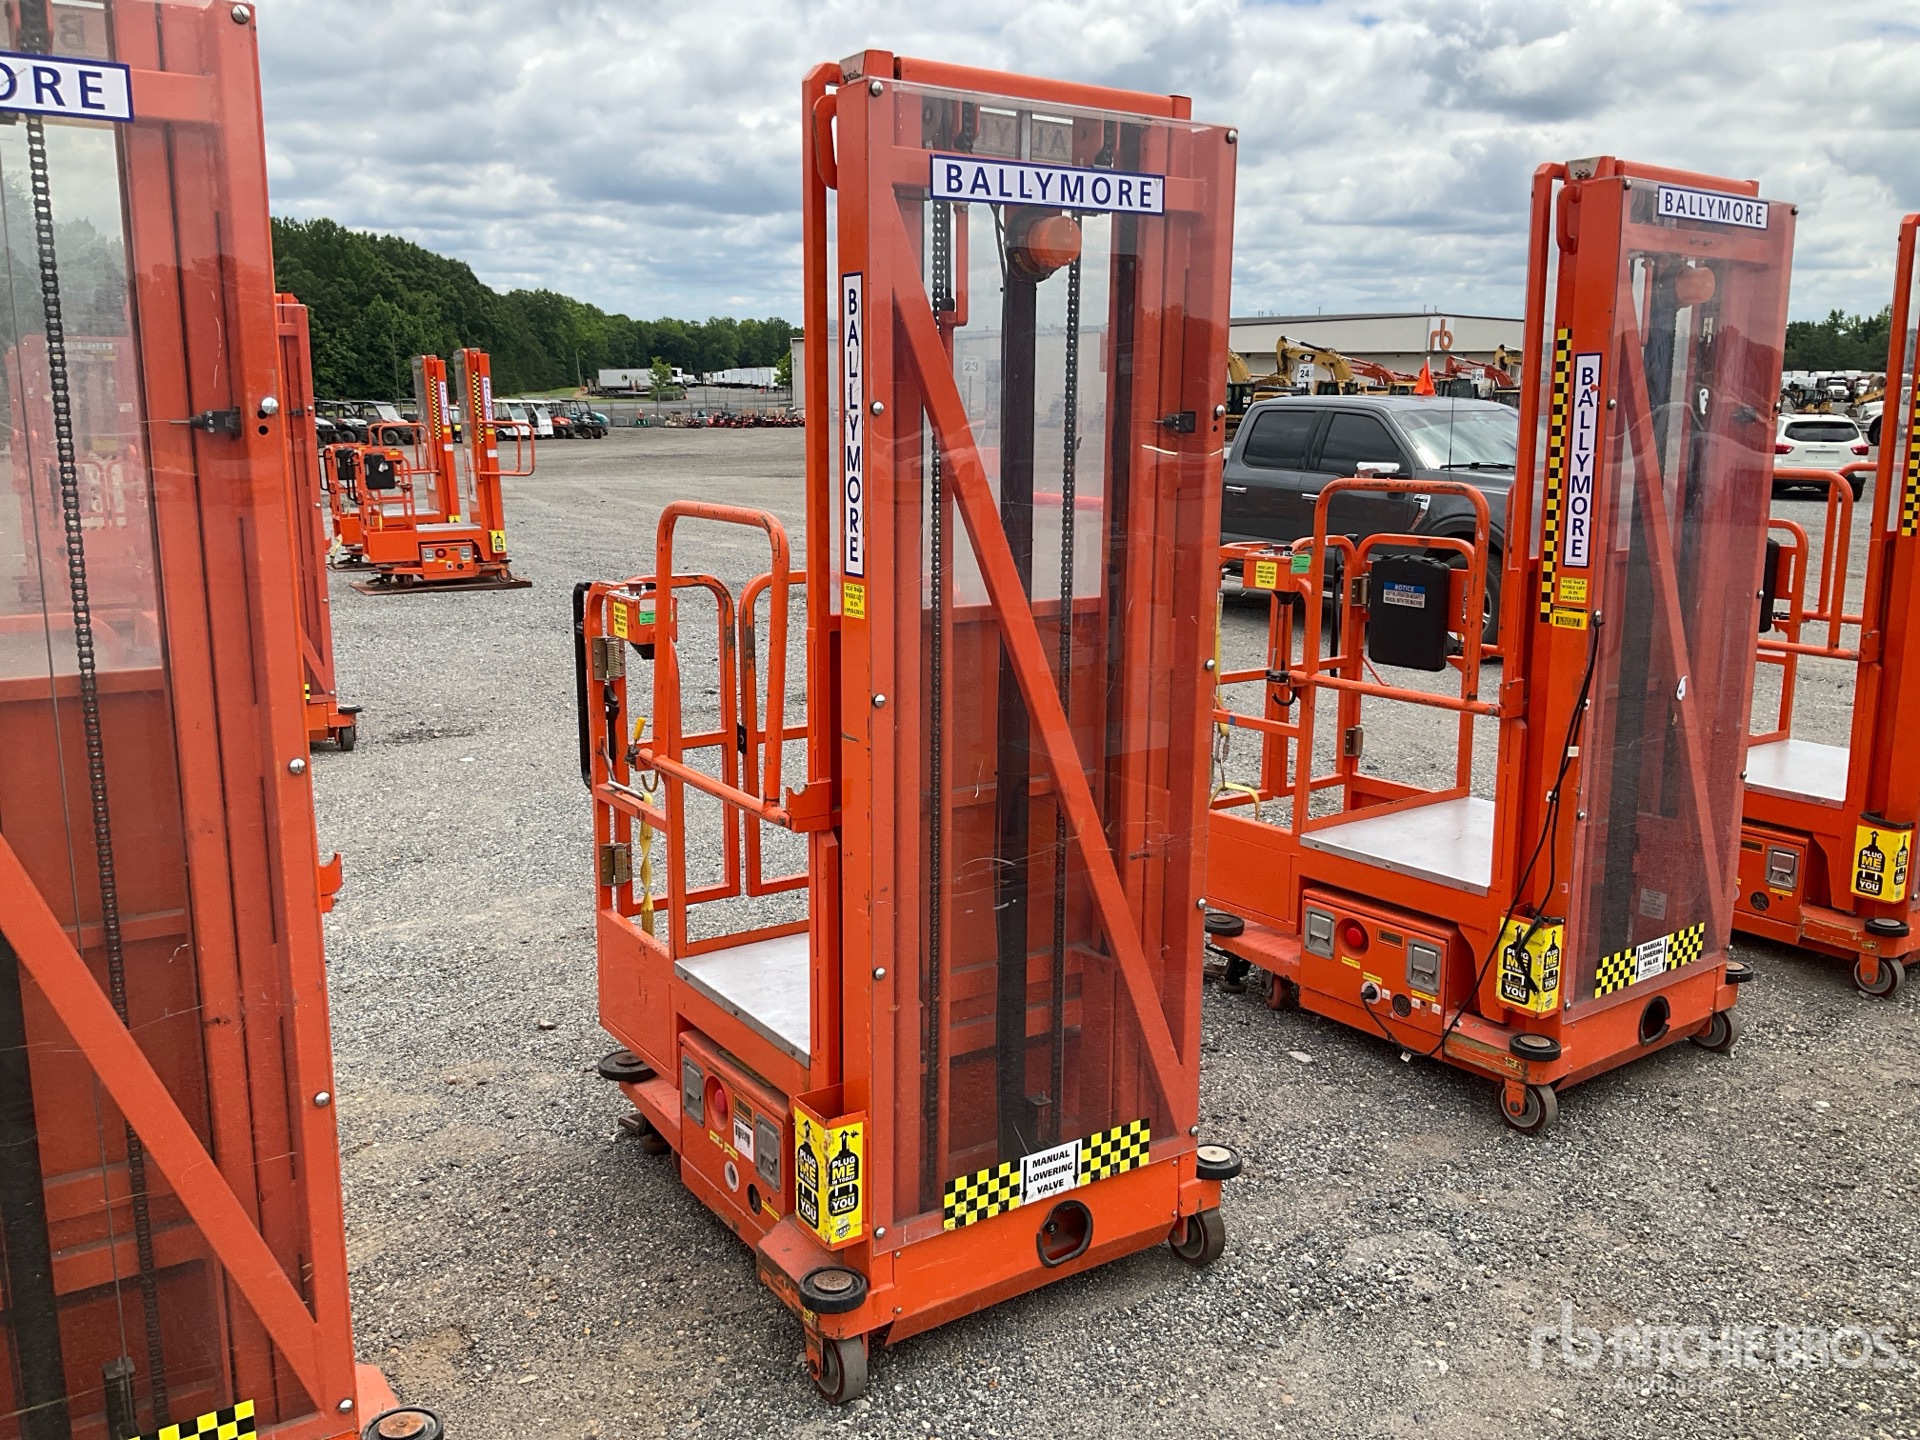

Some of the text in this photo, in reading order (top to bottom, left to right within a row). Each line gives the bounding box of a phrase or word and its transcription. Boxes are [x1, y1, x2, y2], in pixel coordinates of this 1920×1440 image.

[946, 163, 1152, 208] BALLYMORE
[1665, 191, 1763, 225] BALLYMORE
[1430, 319, 1453, 351] rb
[965, 361, 979, 371] 23
[1300, 370, 1310, 378] 24
[847, 288, 861, 562] BALLYMORE
[1571, 367, 1594, 558] BALLYMORE
[1394, 584, 1415, 592] NOTICE
[1862, 850, 1882, 859] PLUG
[1862, 856, 1882, 868] ME
[1860, 880, 1879, 891] YOU
[1642, 940, 1662, 952] MANUAL
[1546, 955, 1558, 966] ME
[1640, 947, 1664, 961] LOWERING
[1643, 956, 1659, 968] VALVE
[1544, 978, 1556, 988] YOU
[1505, 984, 1526, 999] YOU
[800, 1149, 816, 1169] PLUG
[832, 1156, 856, 1169] PLUG
[1032, 1149, 1070, 1169] MANUAL
[800, 1160, 816, 1184] ME
[832, 1163, 855, 1181] ME
[839, 1174, 855, 1184] TODAY
[1028, 1161, 1073, 1183] LOWERING
[1037, 1178, 1065, 1194] VALVE
[800, 1199, 817, 1221] YOU
[832, 1196, 855, 1211] YOU
